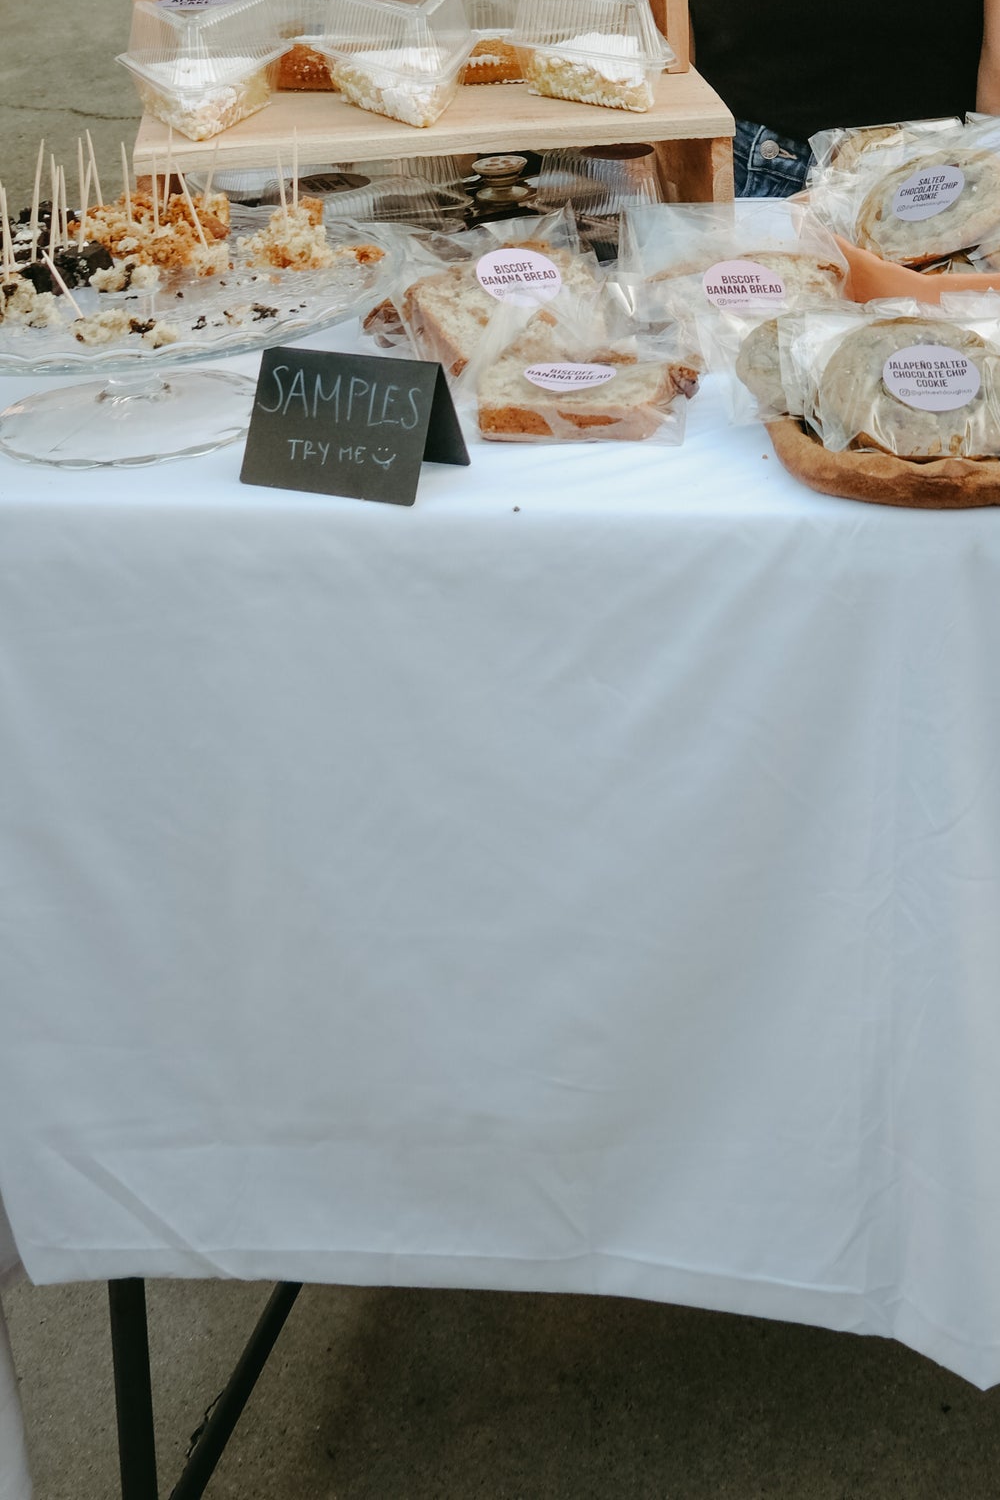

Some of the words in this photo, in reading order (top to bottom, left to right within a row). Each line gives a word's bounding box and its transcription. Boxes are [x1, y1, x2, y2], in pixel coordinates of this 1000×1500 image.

[918, 175, 946, 186] SALTED
[900, 183, 940, 197] CHOCOLATE
[940, 181, 959, 190] CHIP
[912, 192, 939, 202] COOKIE
[493, 262, 534, 274] BISCOFF
[481, 273, 522, 286] BANANA
[523, 269, 557, 282] BREAD
[721, 275, 761, 284] BISCOFF
[706, 285, 748, 295] BANANA
[749, 284, 782, 294] BREAD
[888, 360, 933, 370] JALAPEÑO
[934, 360, 968, 369] SALTED
[527, 369, 572, 380] BANANA
[550, 368, 595, 376] BISCOFF
[892, 370, 945, 379] CHOCOLATE
[946, 369, 967, 377] CHIP
[916, 379, 949, 388] COOKIE
[257, 365, 422, 429] SAMPLES
[287, 439, 330, 465] TRY
[339, 446, 366, 464] ME
